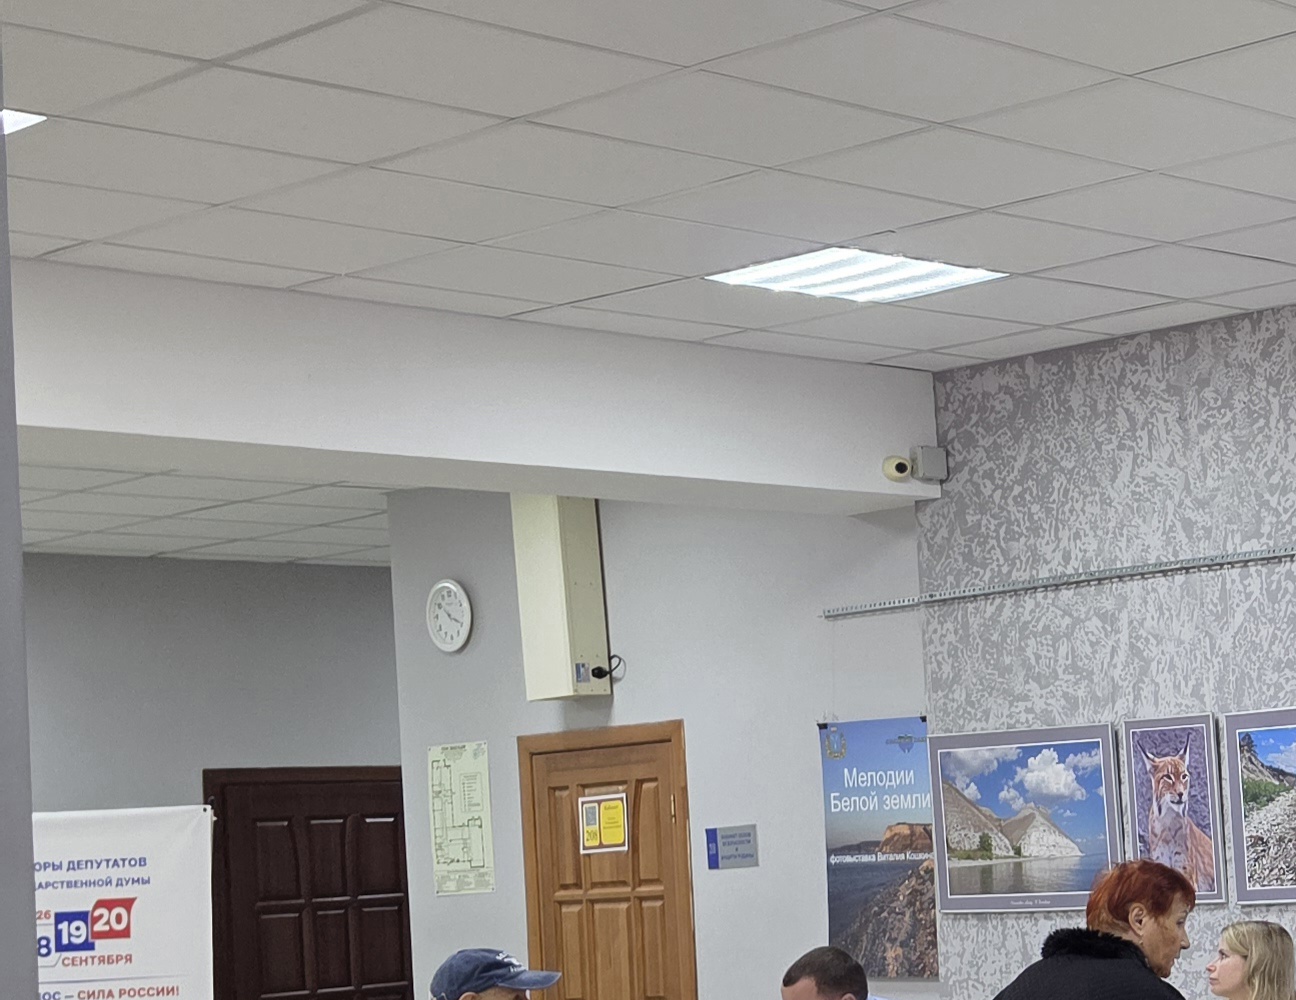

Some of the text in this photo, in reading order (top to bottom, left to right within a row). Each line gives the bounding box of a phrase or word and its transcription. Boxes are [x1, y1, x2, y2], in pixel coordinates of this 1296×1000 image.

[843, 767, 915, 789] Мелодии
[830, 791, 931, 813] Белой земли
[34, 857, 147, 872] ОРЫ ДЕПУТАТОВ
[829, 853, 876, 865] фотовыставка
[877, 851, 905, 862] Виталия
[36, 876, 151, 891] АРСТВЕННОЙ ДУМЫ
[36, 910, 52, 920] 26
[37, 906, 129, 957] 8 19 20
[61, 954, 133, 967] СЕНТЯБРЯ
[77, 988, 115, 1000] СИЛА
[118, 986, 180, 999] РОССИИ!
